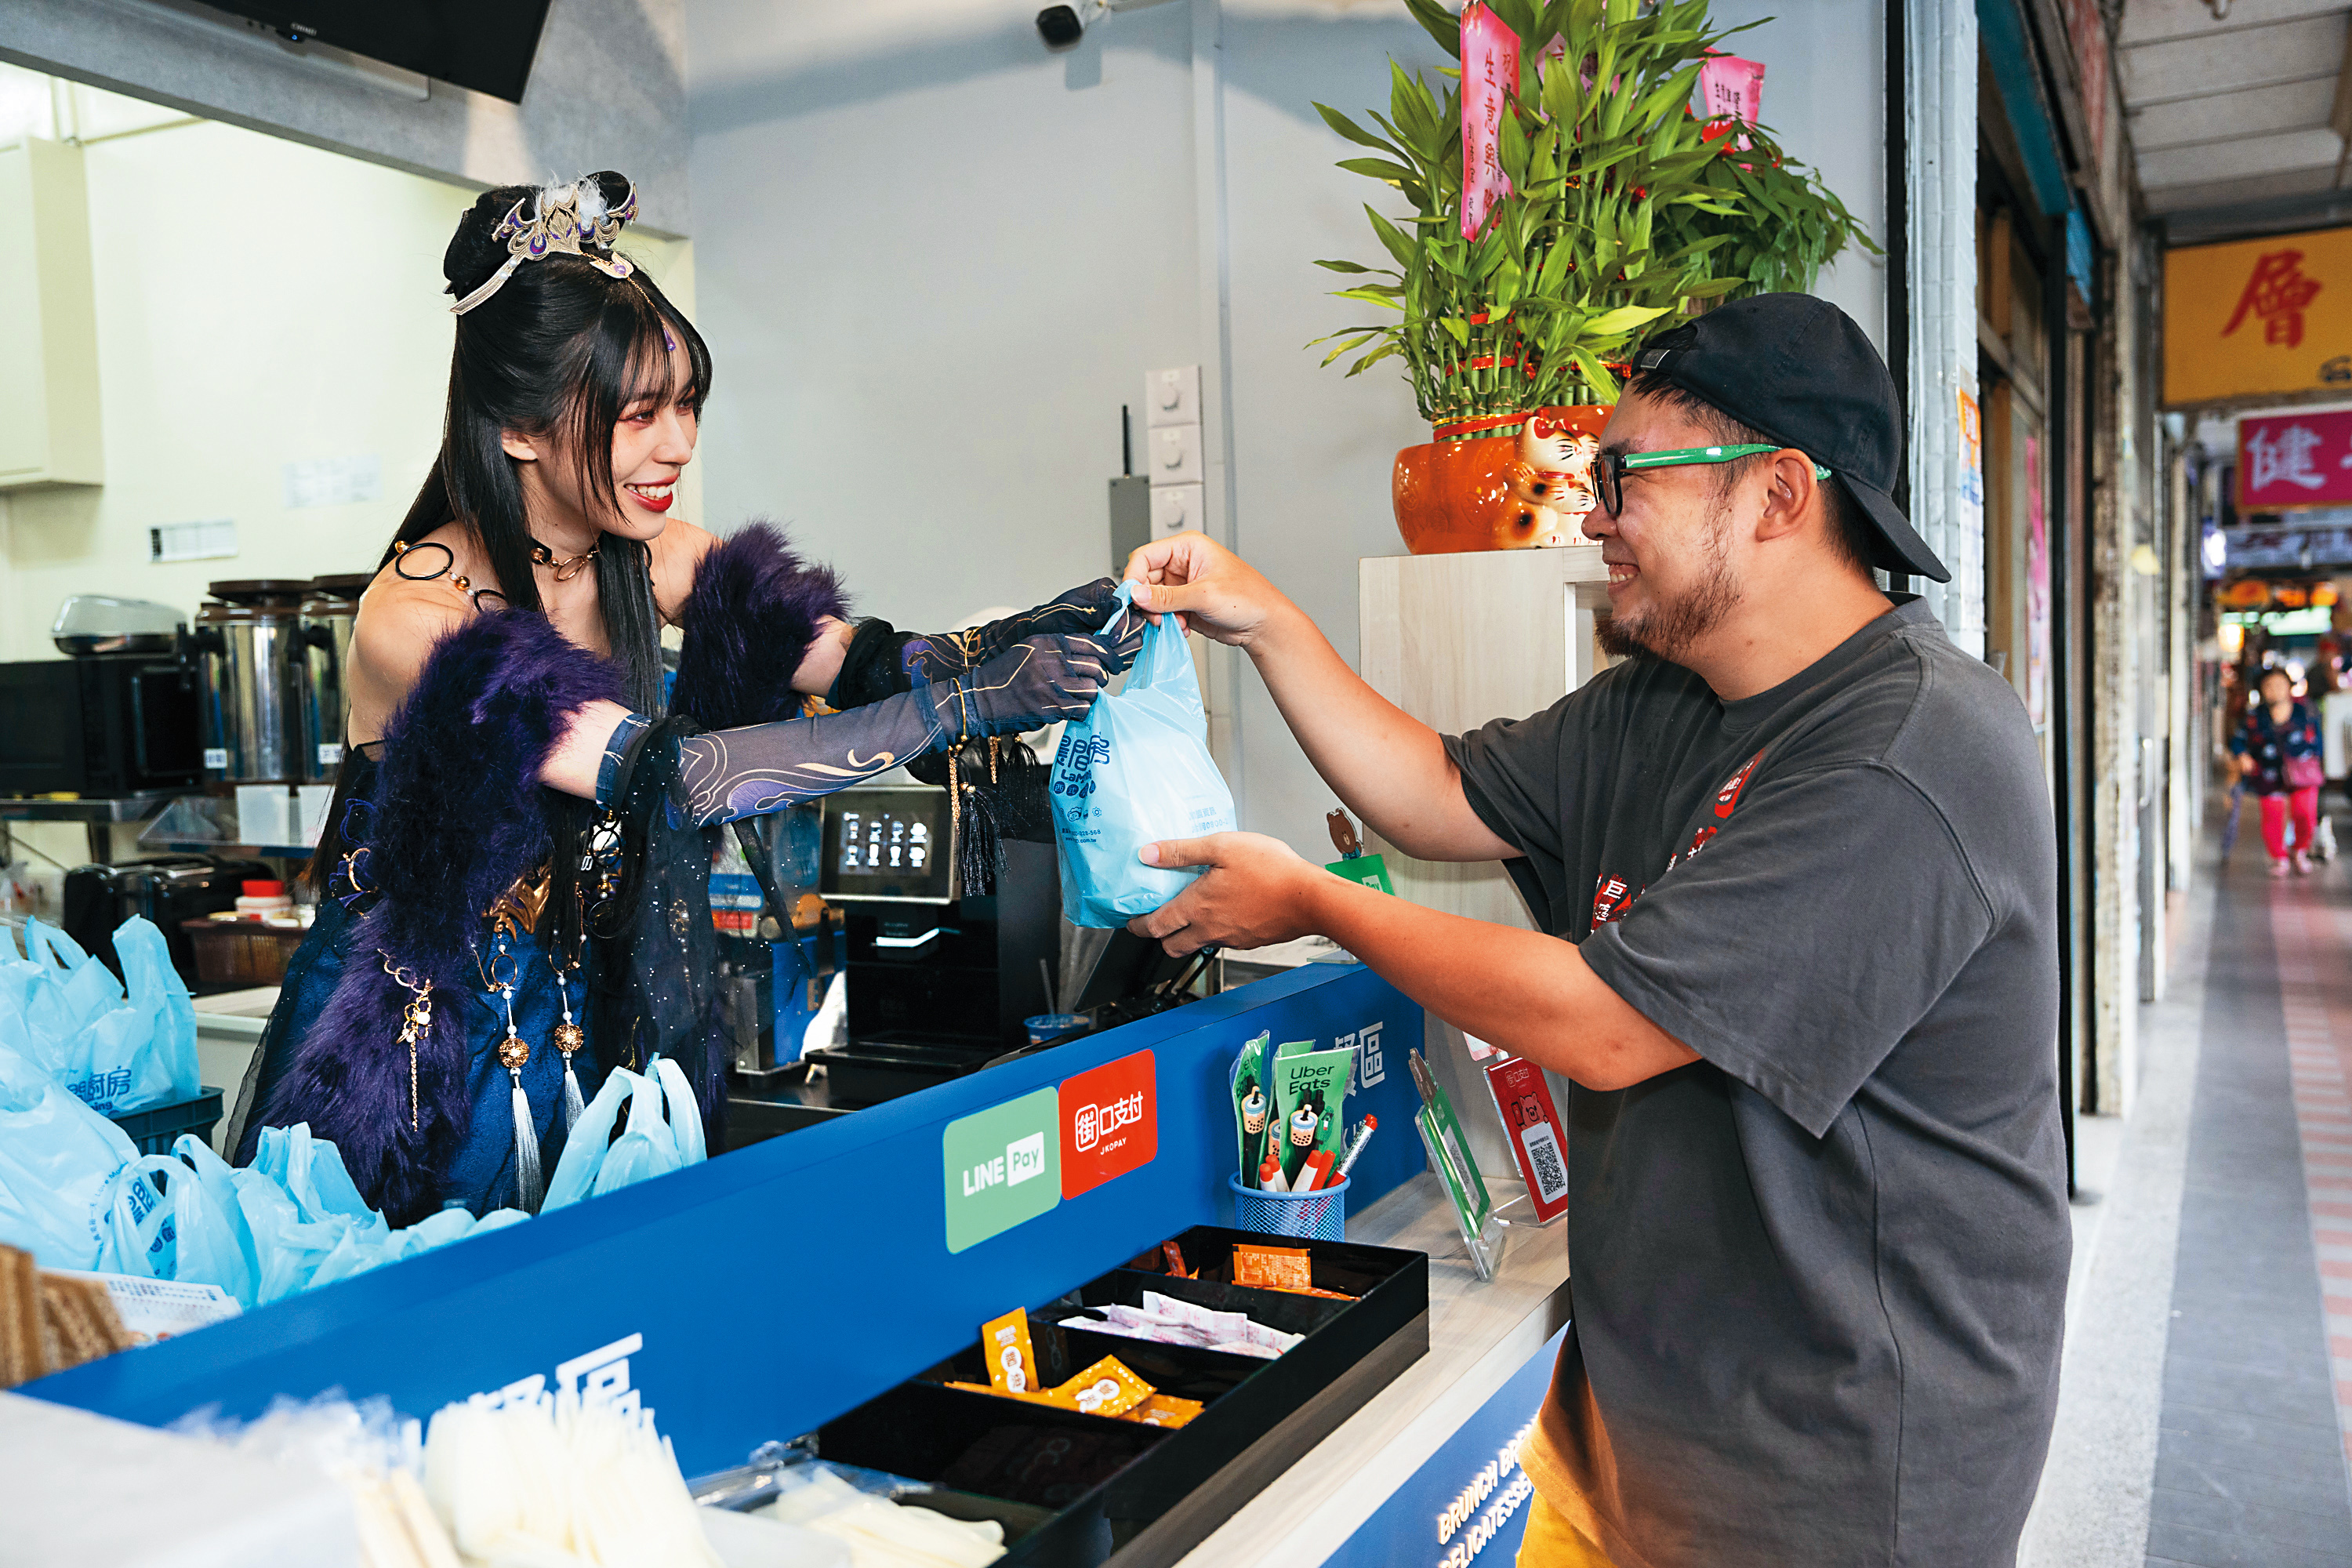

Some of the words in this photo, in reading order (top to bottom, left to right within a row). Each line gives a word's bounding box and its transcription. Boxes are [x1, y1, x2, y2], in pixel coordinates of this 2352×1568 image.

[2220, 248, 2323, 349] 層
[2246, 424, 2352, 492] 健
[1289, 1078, 1330, 1096] Eats
[1290, 1065, 1335, 1080] Uber
[1074, 1091, 1144, 1153] 街口支付
[1099, 1137, 1127, 1156] JKOPAY
[963, 1156, 1005, 1197] LINE
[1013, 1147, 1040, 1172] Pay
[1438, 1459, 1498, 1545] BRUNCH
[1439, 1470, 1535, 1568] ELICATESSE
